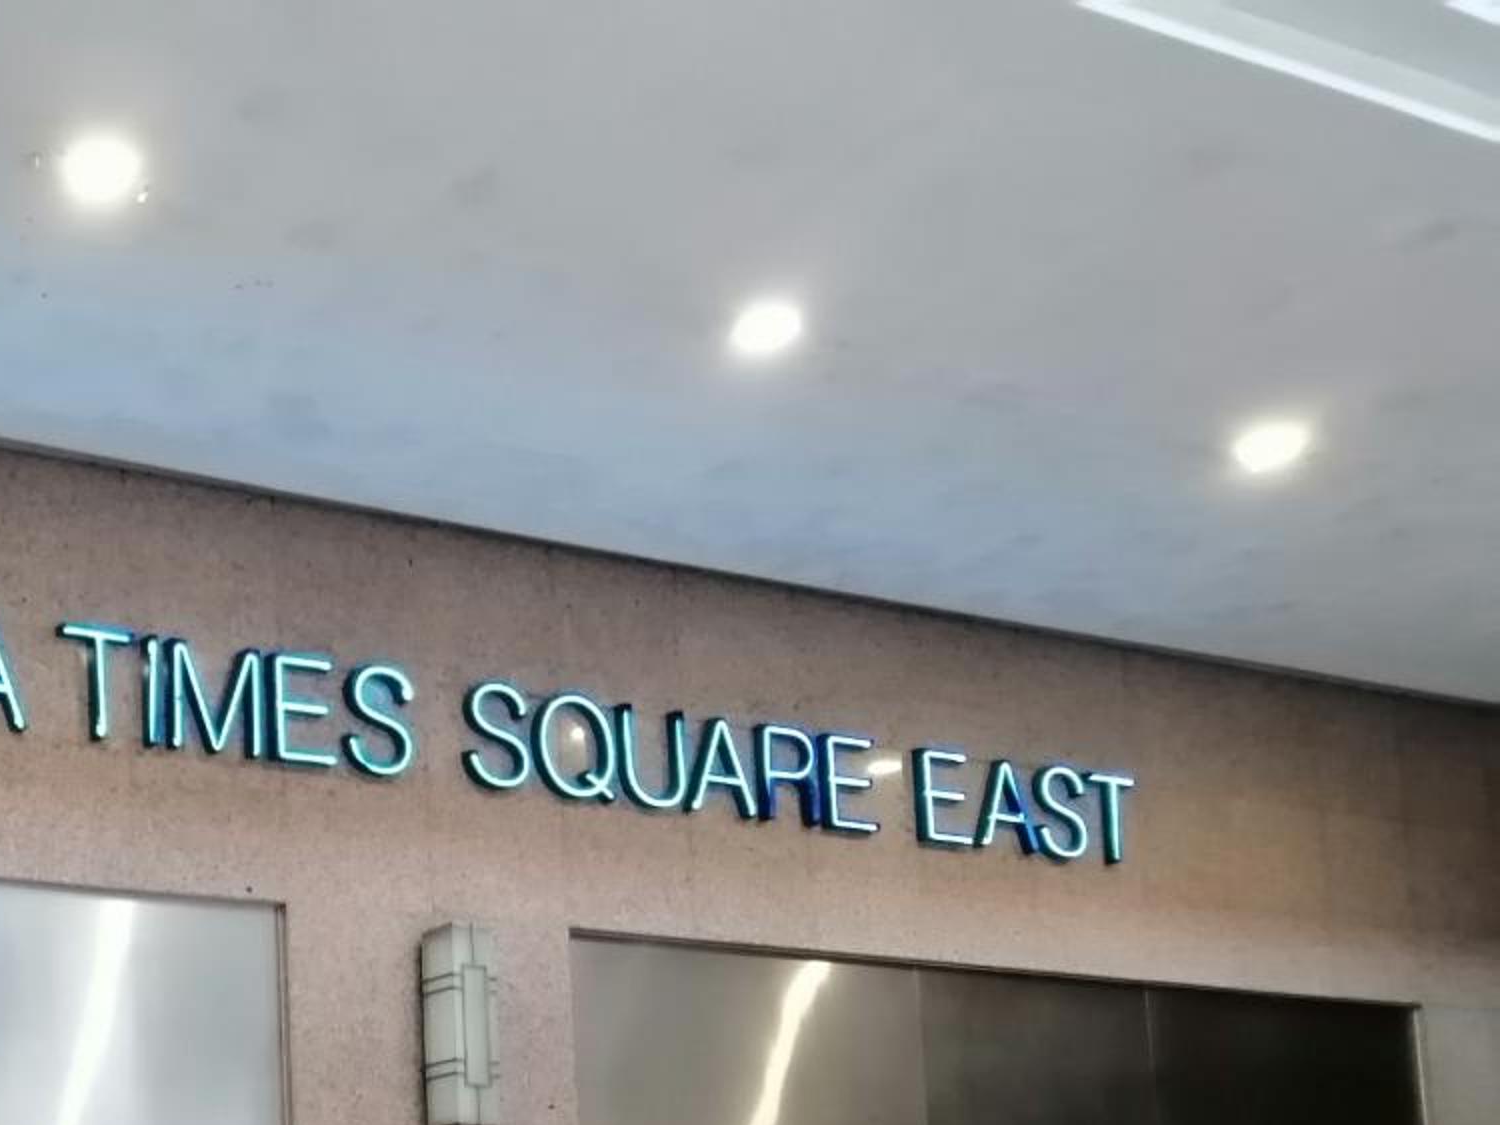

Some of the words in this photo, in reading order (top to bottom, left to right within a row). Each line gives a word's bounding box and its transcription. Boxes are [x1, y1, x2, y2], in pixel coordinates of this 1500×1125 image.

[56, 620, 415, 777] TIMES
[463, 681, 881, 834] SQUARE
[912, 746, 1136, 865] EAST
